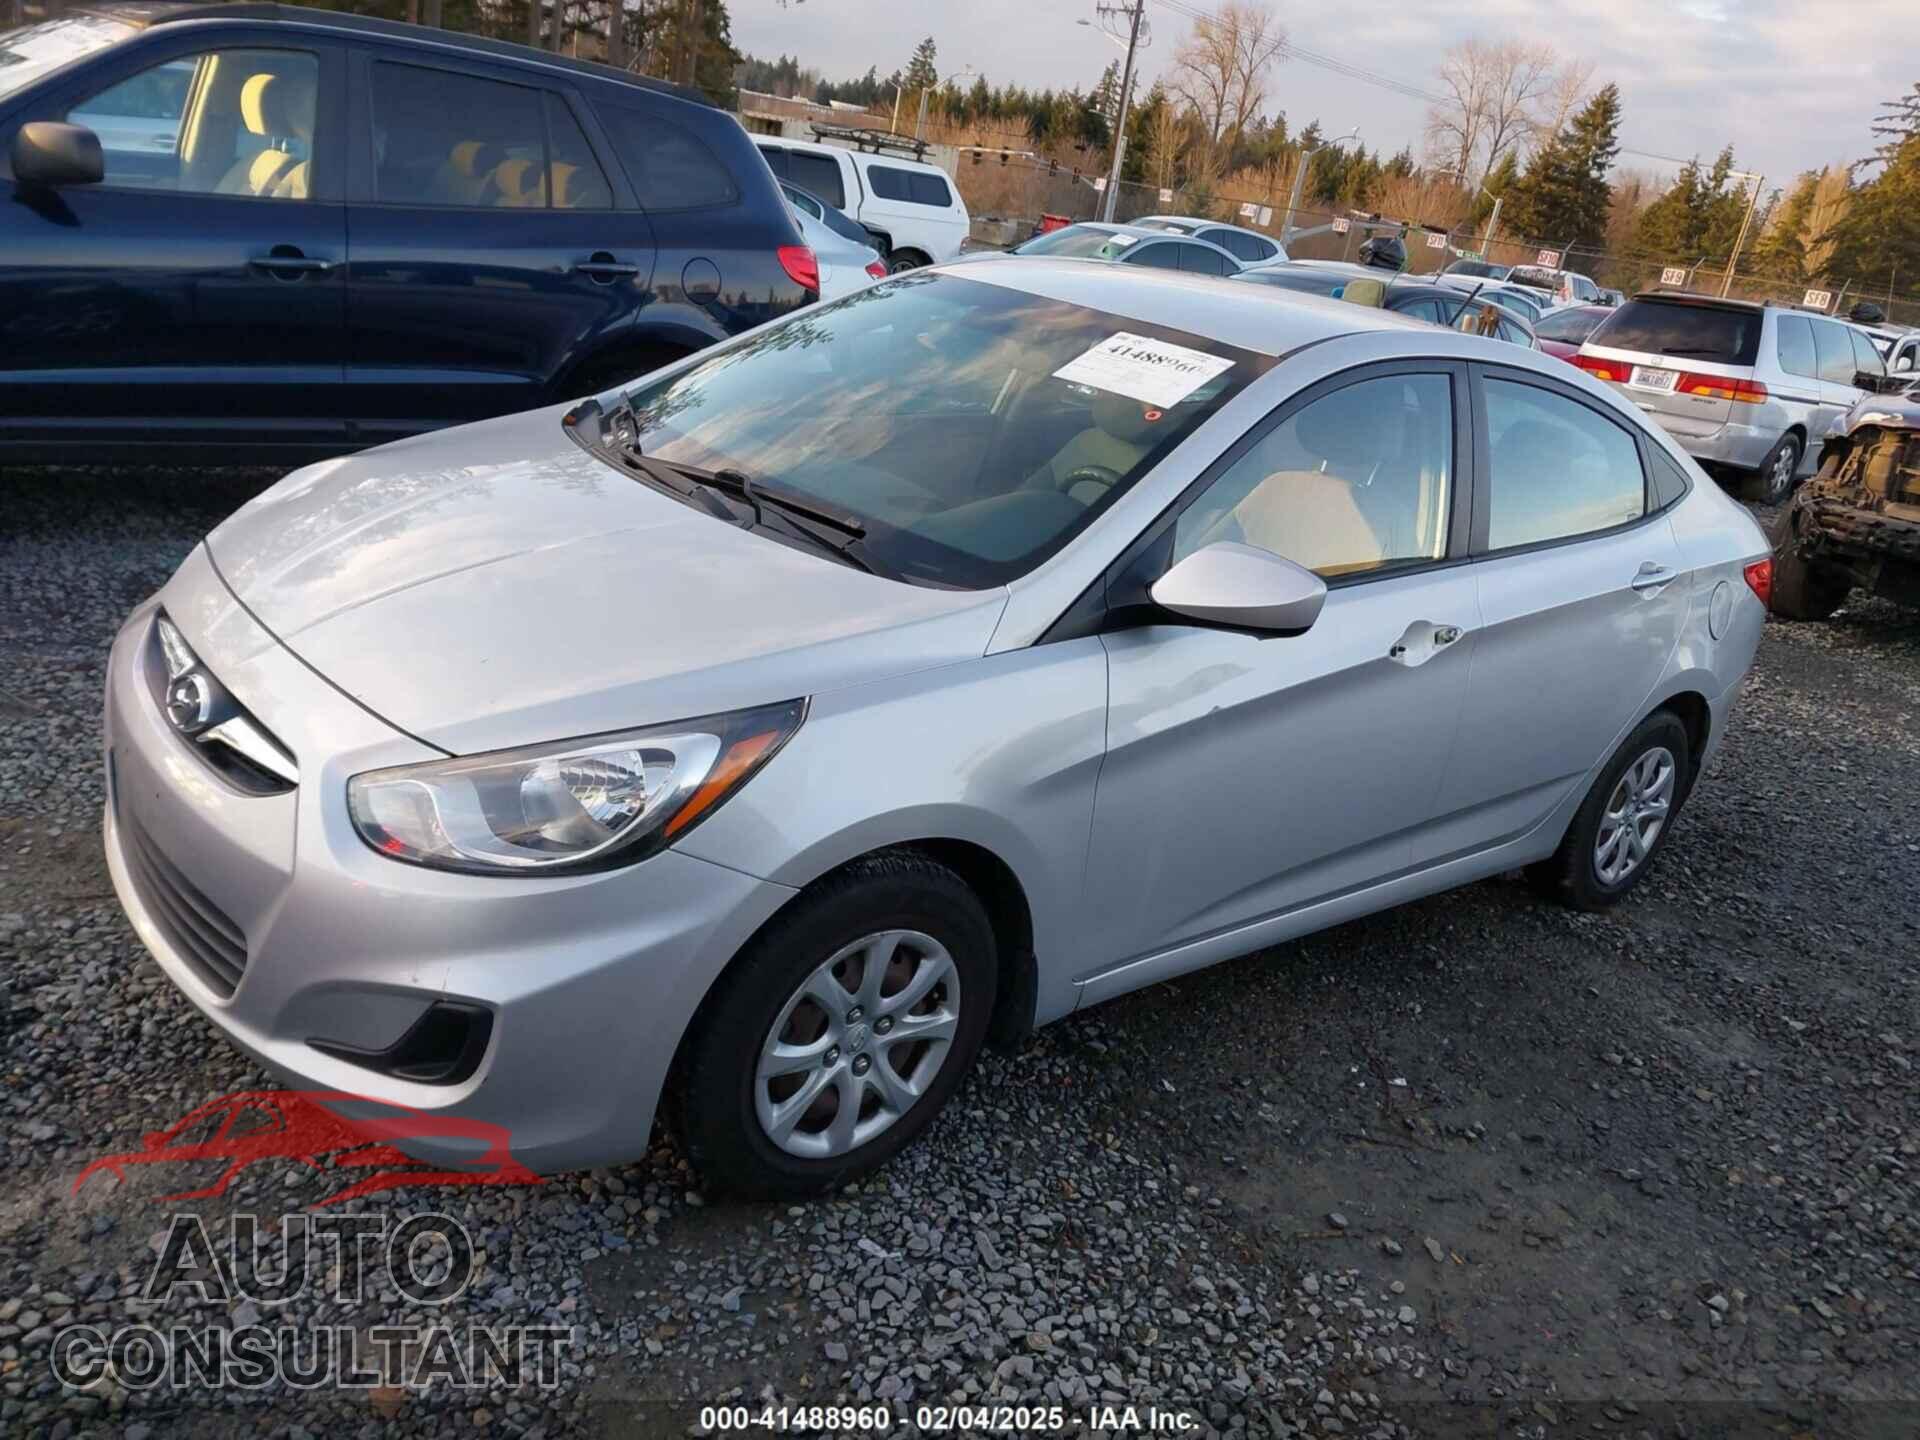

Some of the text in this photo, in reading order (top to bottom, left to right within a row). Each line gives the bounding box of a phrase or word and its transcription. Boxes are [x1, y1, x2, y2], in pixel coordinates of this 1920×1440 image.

[1539, 252, 1558, 265] SF10
[1663, 270, 1682, 284] SF9
[1807, 291, 1828, 306] SF8
